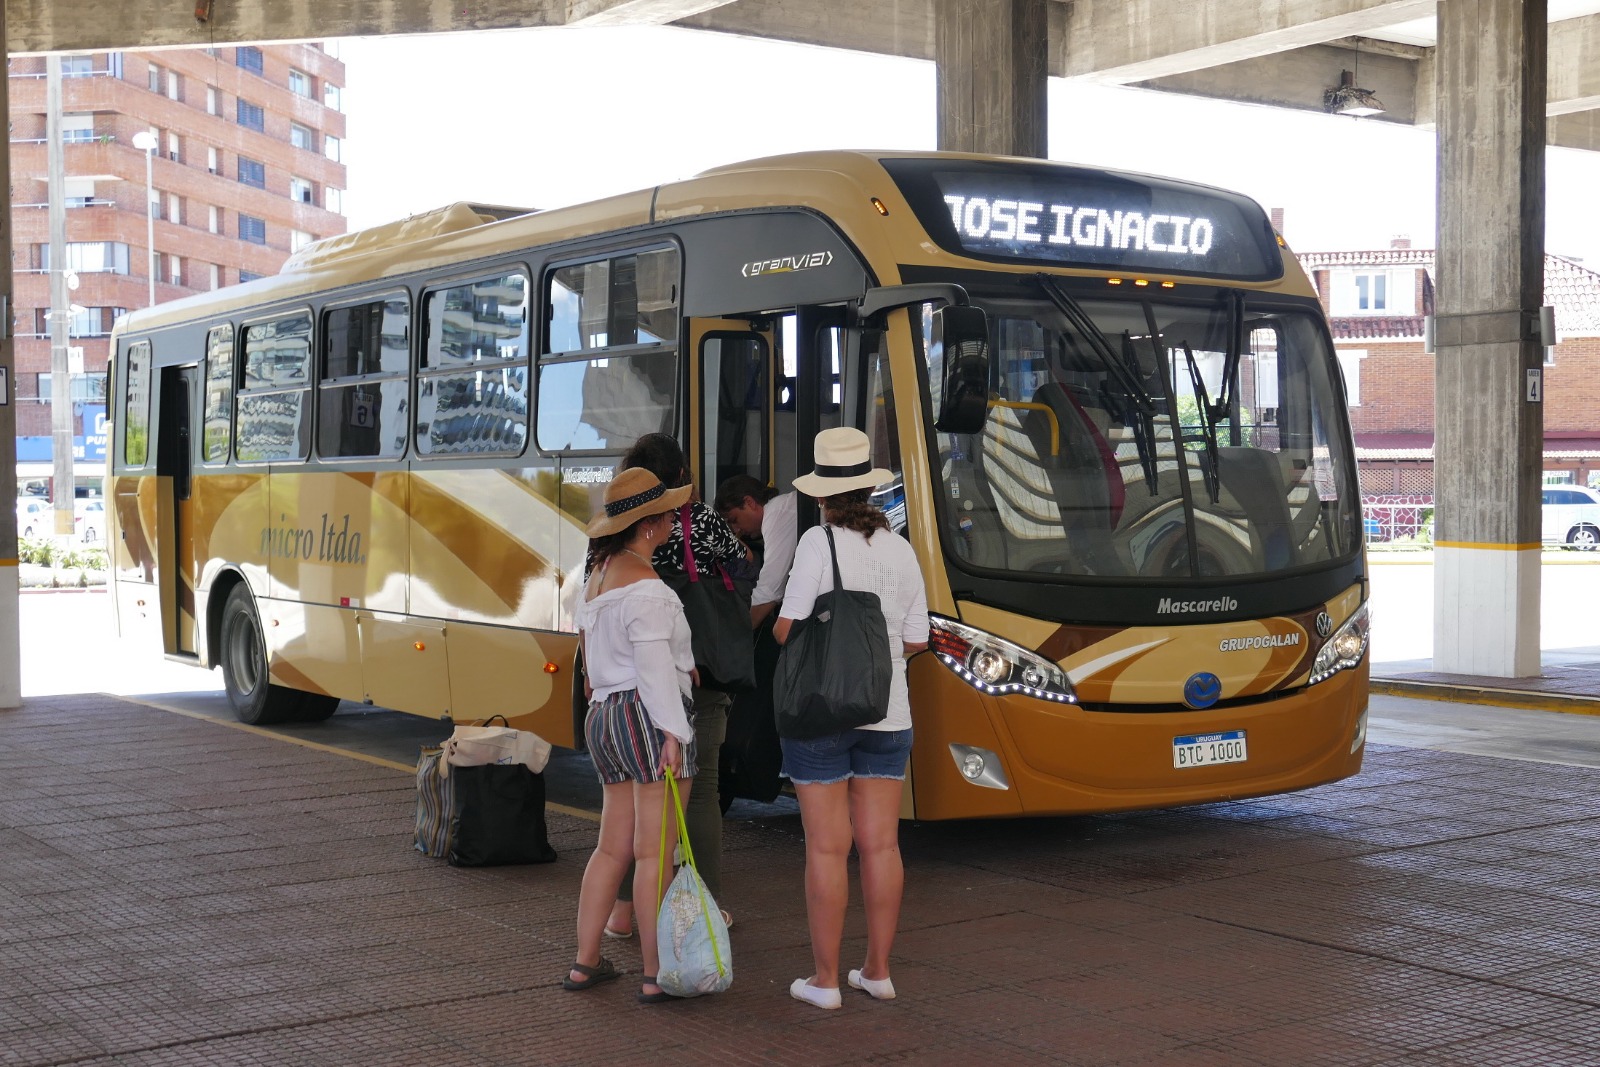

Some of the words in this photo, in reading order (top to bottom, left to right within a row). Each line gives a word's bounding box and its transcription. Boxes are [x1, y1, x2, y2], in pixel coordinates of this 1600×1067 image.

[944, 195, 1043, 243] JOSE
[1049, 204, 1214, 255] IGNACIO
[1530, 381, 1537, 400] 4
[260, 512, 315, 561] micro
[319, 512, 367, 567] ltda.
[1157, 596, 1239, 614] Mascarello
[1219, 632, 1300, 652] GRUPOGALAN
[1195, 734, 1223, 743] URUGUAY
[1178, 745, 1204, 765] BTC
[1209, 741, 1242, 762] 1000
